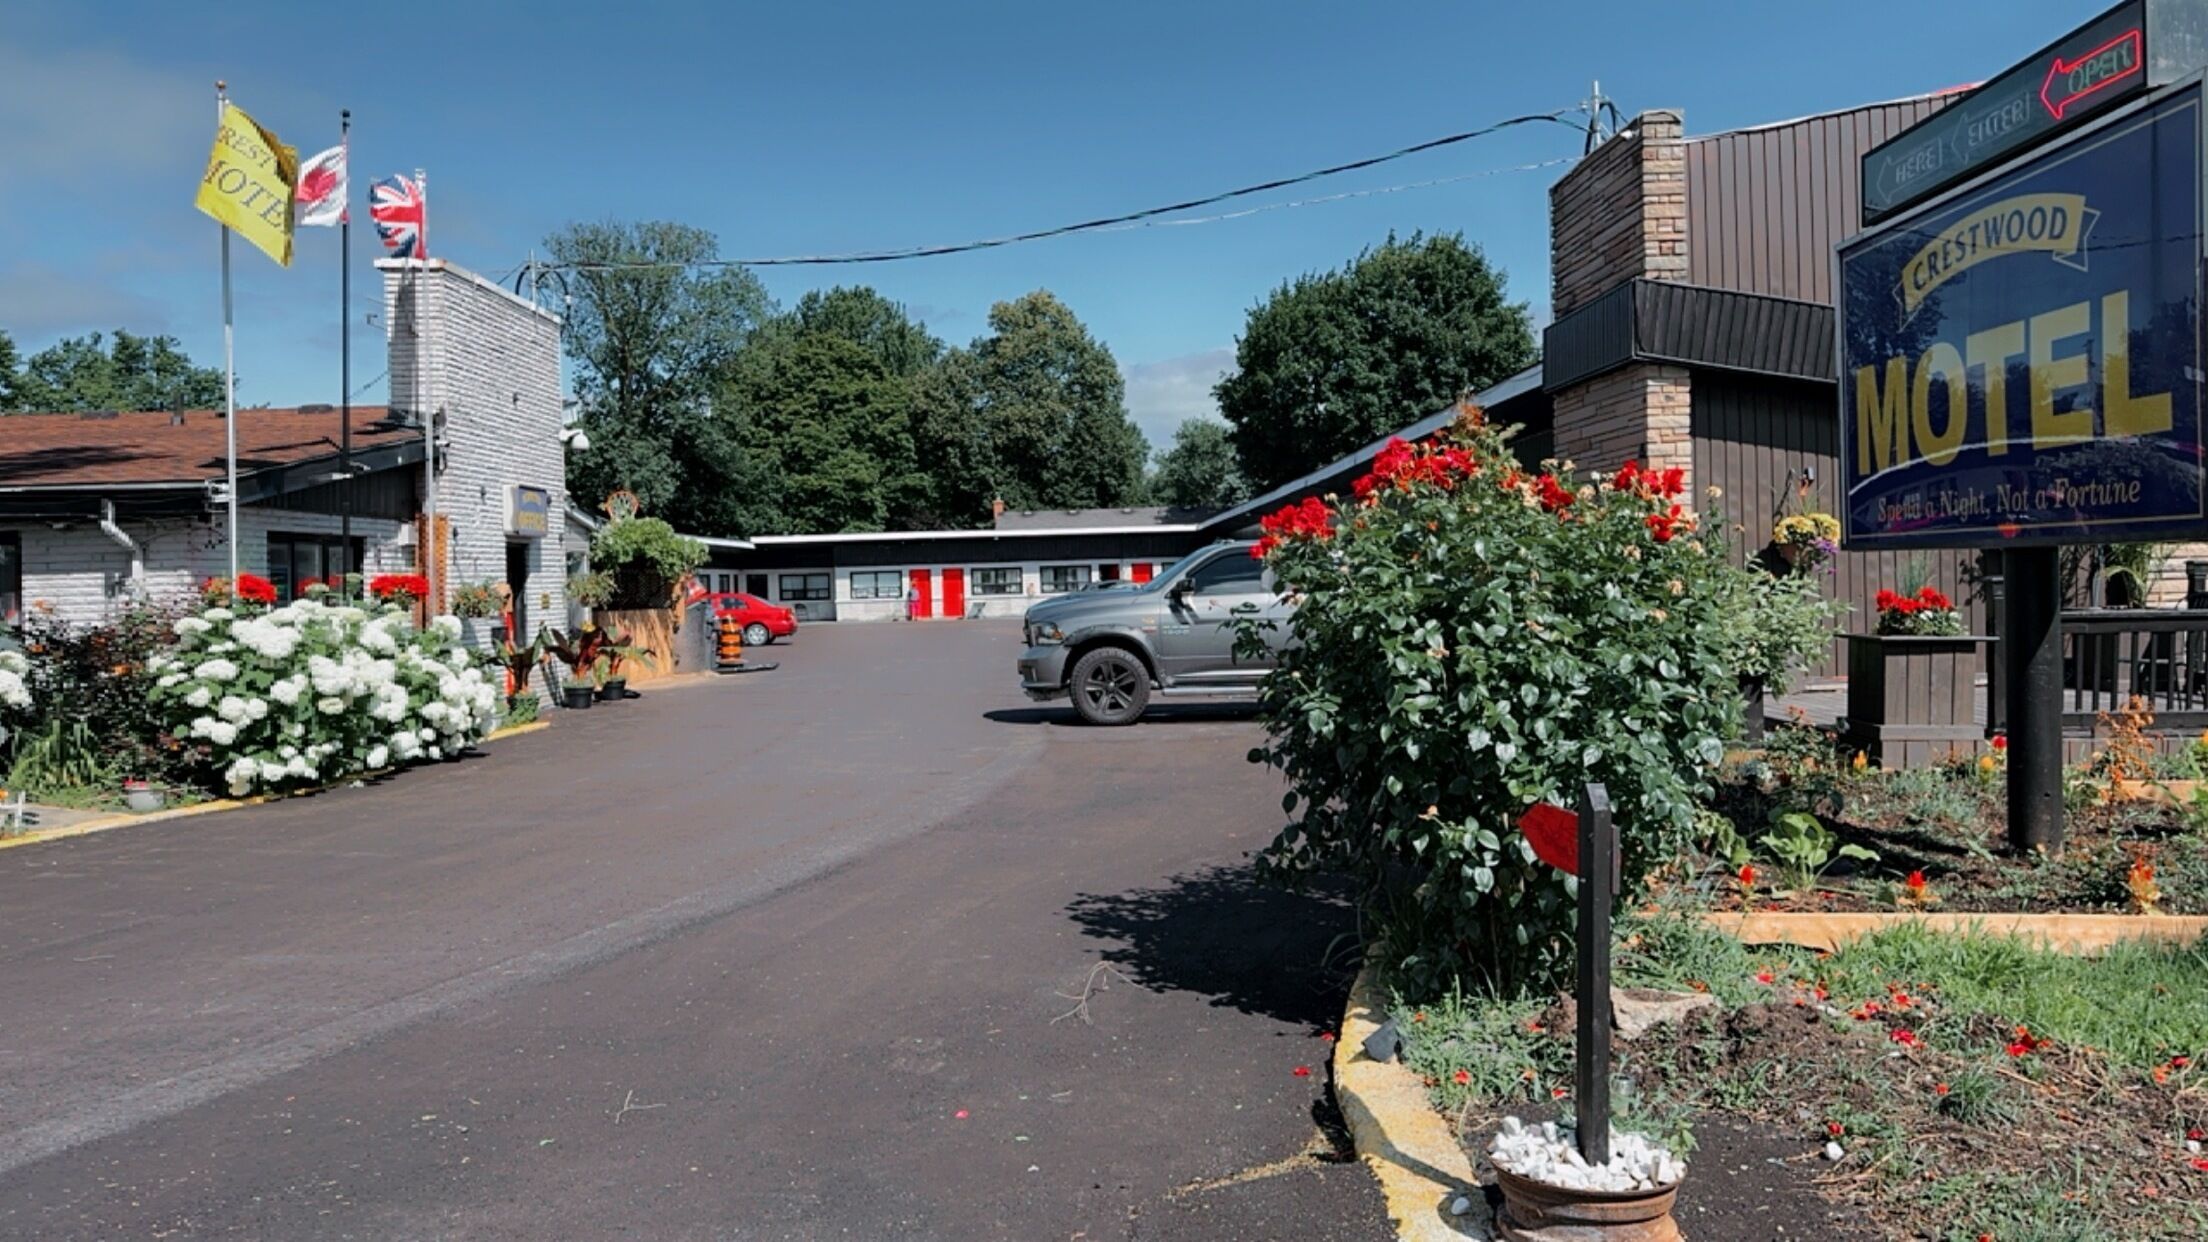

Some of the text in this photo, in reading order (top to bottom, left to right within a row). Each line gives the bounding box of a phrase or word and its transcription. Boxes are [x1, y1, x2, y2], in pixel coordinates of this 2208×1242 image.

[2068, 41, 2132, 94] OPEN
[1968, 99, 2024, 148] ENTER
[1895, 147, 1936, 184] HERE
[1912, 205, 2068, 291] CRESTWOOD
[1856, 290, 2173, 476] MOTEL
[1877, 477, 2142, 523] Spend a Night, Not a Fortune
